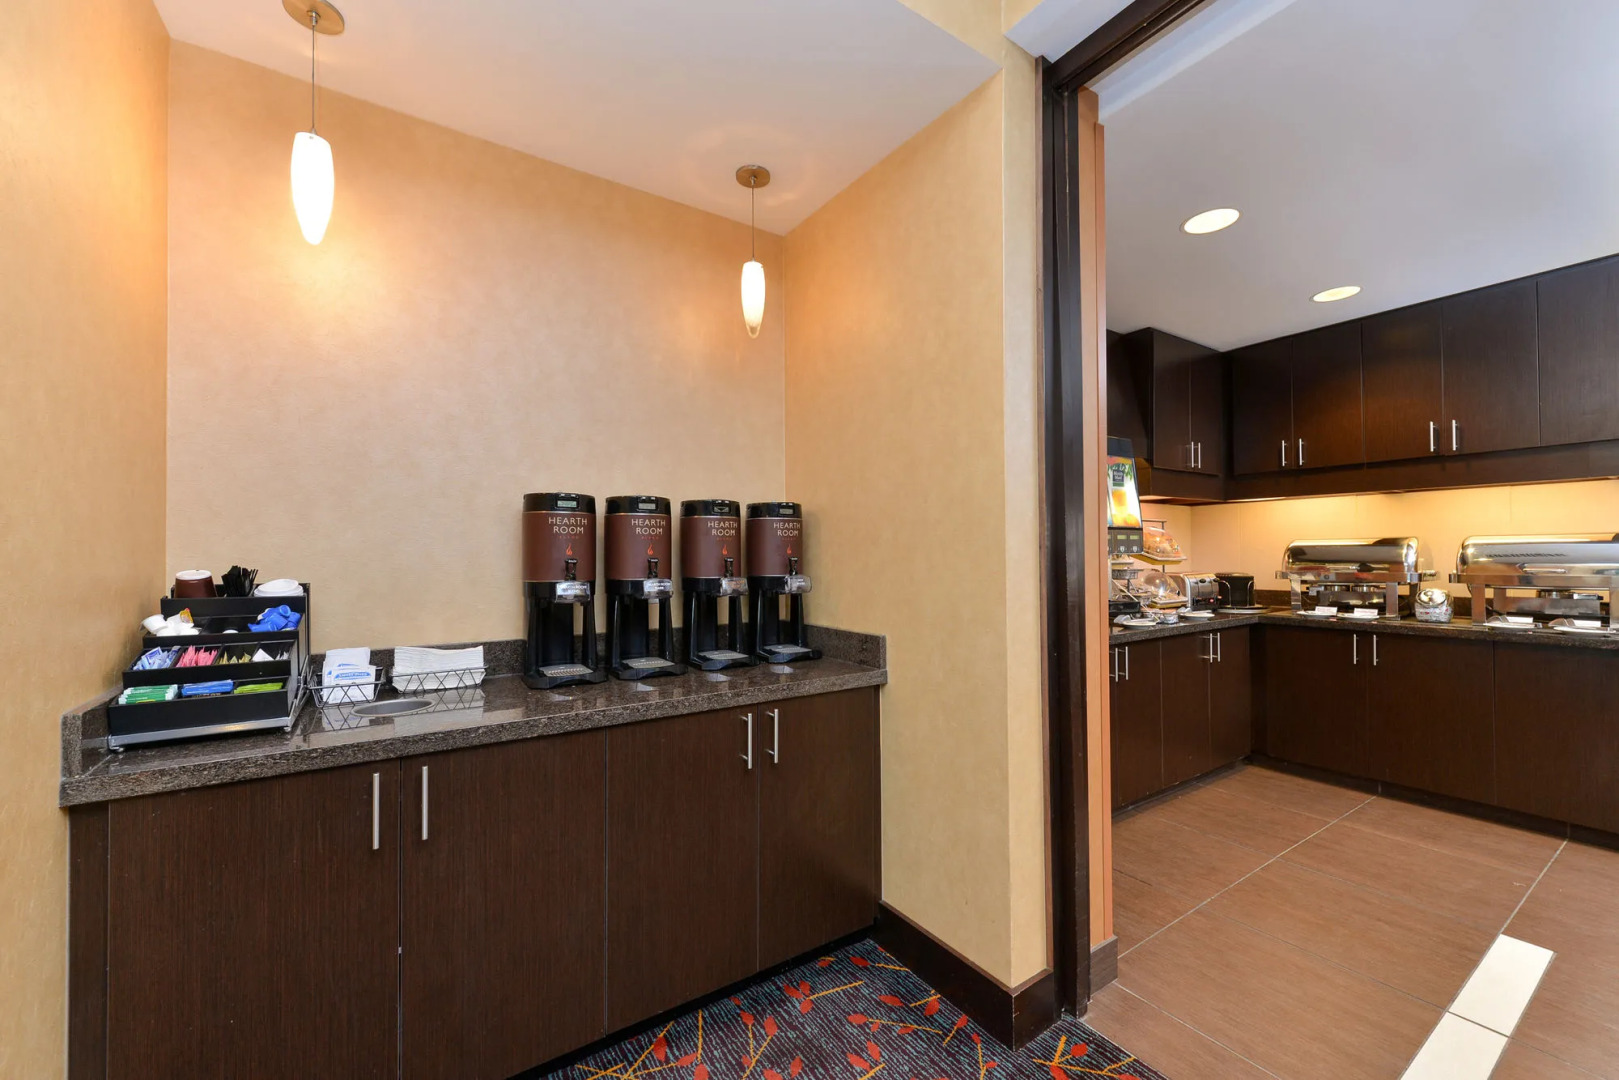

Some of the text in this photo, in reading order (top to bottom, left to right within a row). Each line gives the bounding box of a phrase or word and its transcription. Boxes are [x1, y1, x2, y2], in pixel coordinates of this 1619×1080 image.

[548, 516, 588, 525] HEARTH
[631, 518, 666, 527] HEARTH
[707, 520, 738, 528] HEARTH
[553, 526, 584, 534] ROOM
[635, 527, 663, 535] ROOM
[777, 529, 799, 537] ROOM
